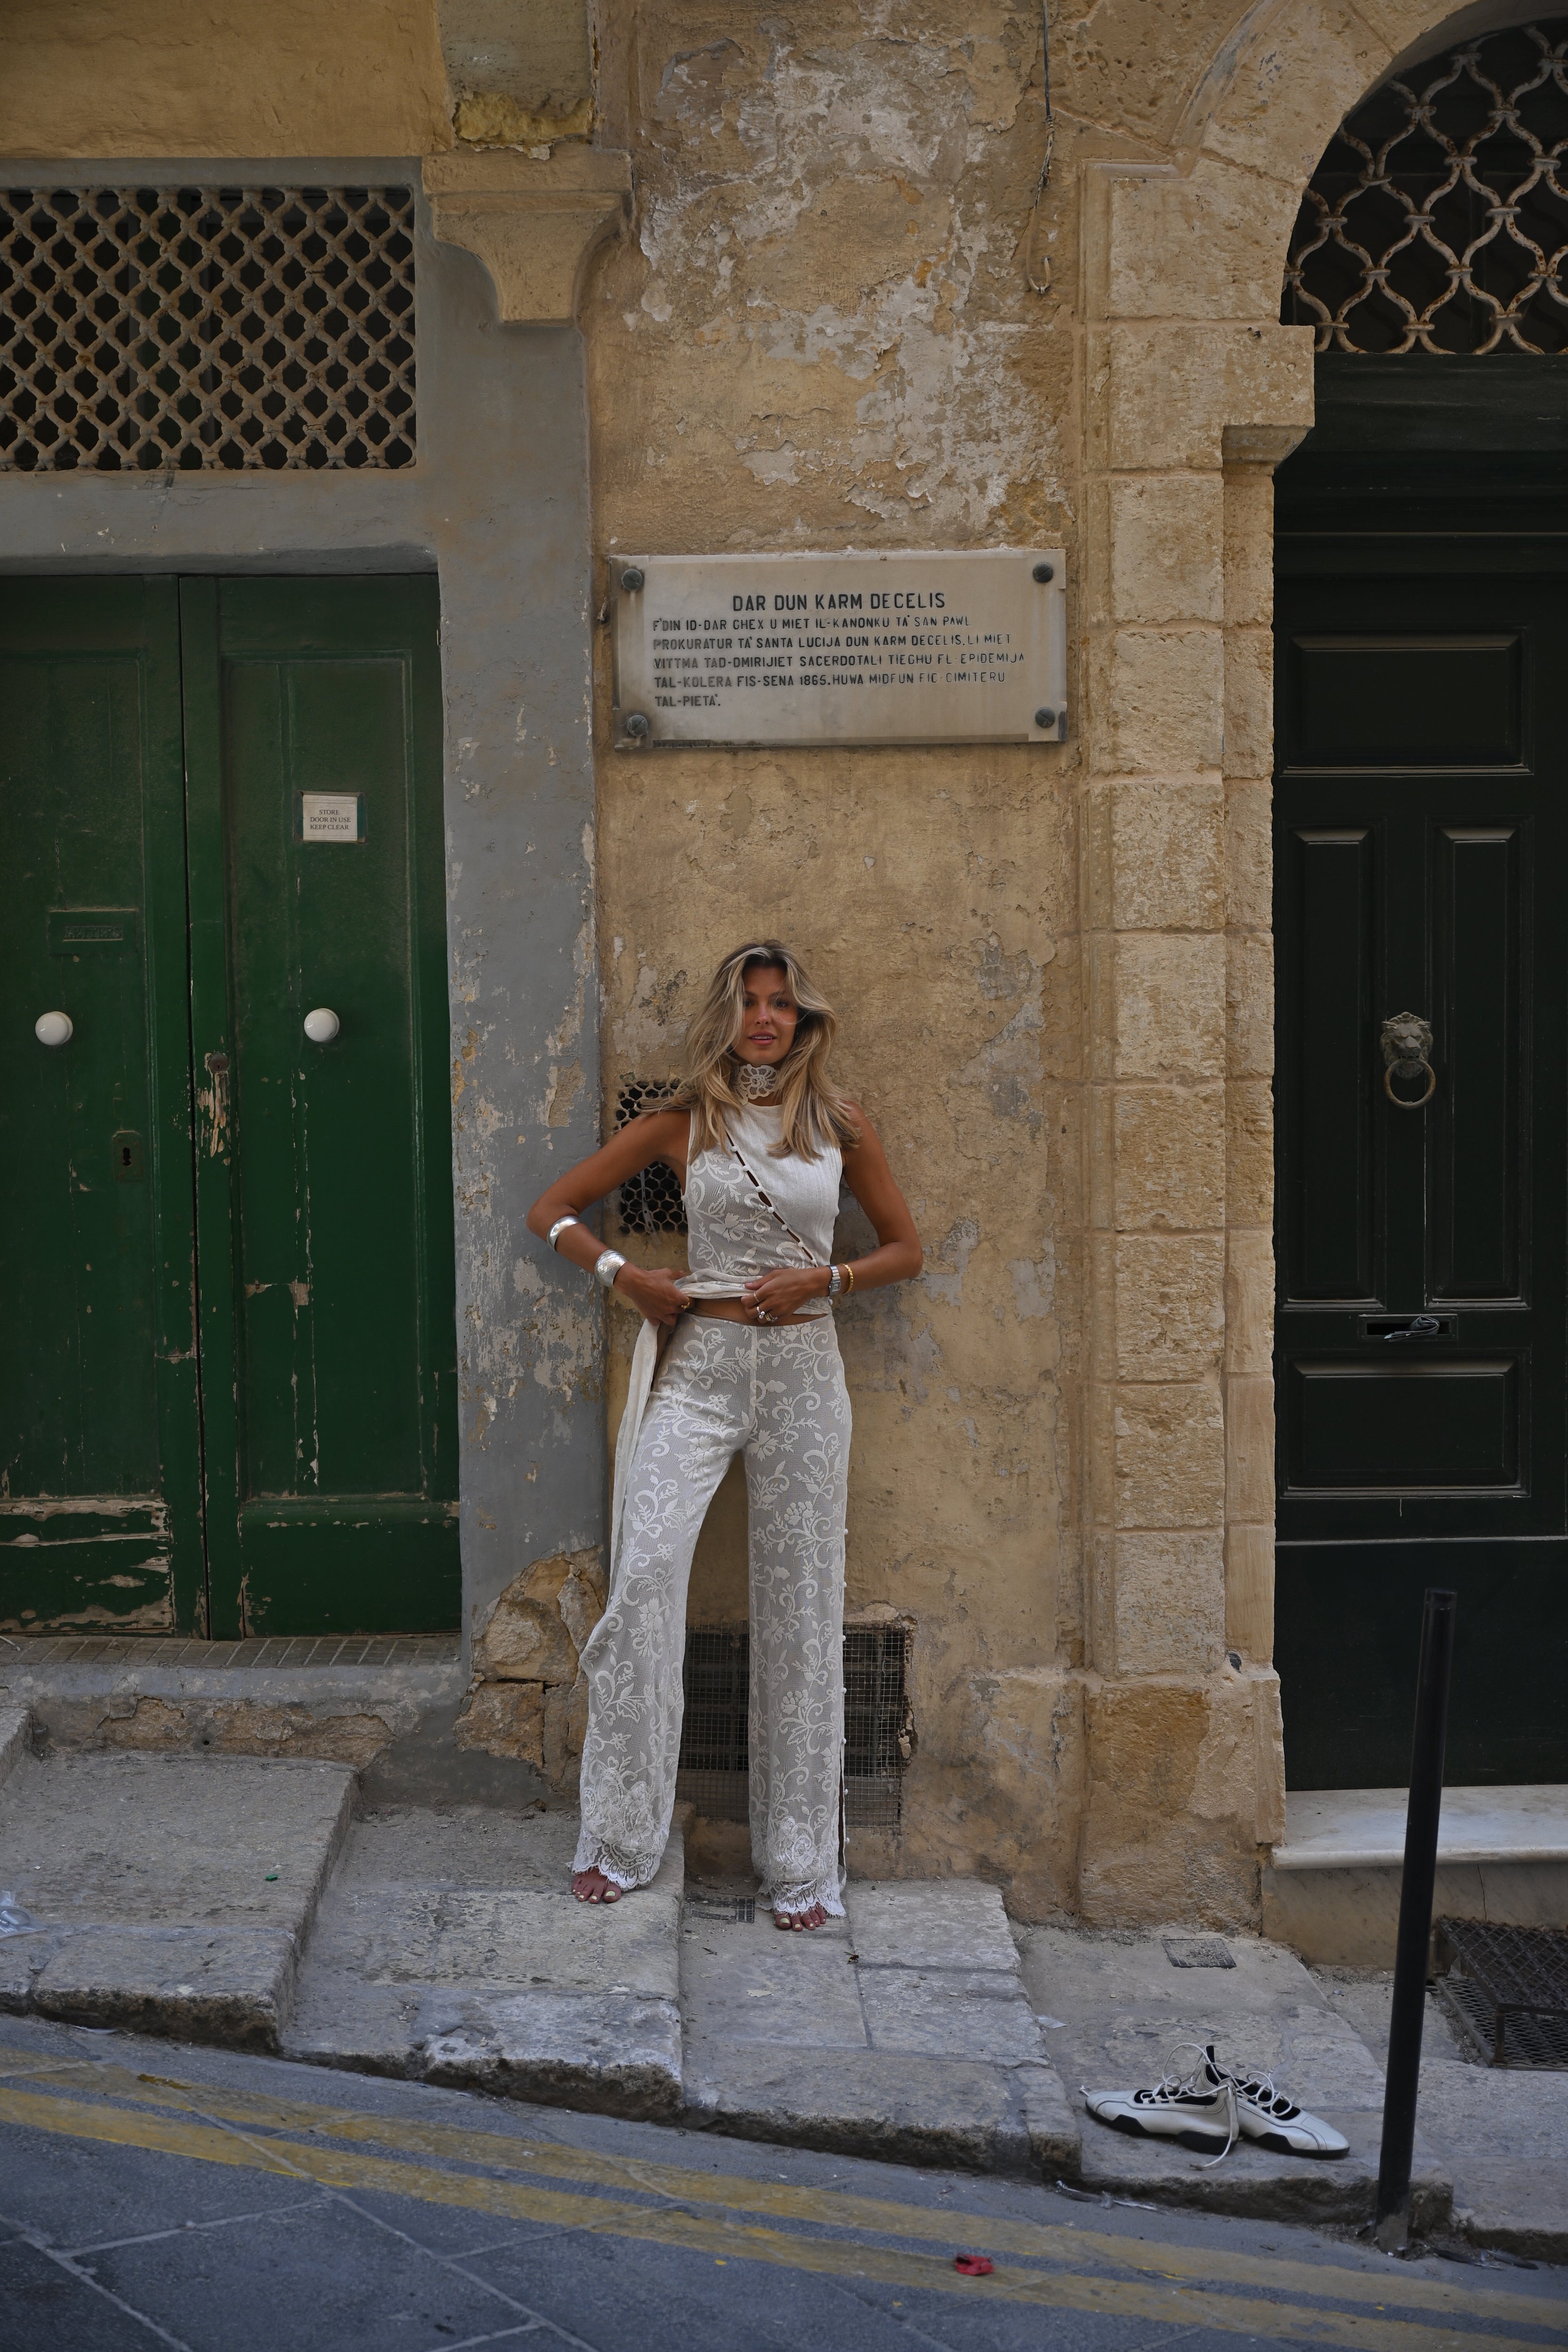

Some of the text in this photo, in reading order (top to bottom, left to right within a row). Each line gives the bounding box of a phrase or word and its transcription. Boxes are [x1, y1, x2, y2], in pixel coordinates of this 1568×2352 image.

[733, 593, 945, 611] DAR DUN KARM DECELIS
[686, 620, 726, 630] ID-DAR
[733, 619, 763, 630] GHEX
[771, 619, 776, 629] U
[783, 619, 809, 628] MIET
[816, 618, 890, 628] IL-KANONKU
[915, 617, 937, 627] SAN
[943, 616, 971, 626] PAWL
[653, 638, 732, 650] PROKURATUR
[756, 637, 793, 648] SANTA
[799, 637, 840, 648] LUCIJA
[846, 636, 868, 646] DUN
[875, 636, 906, 646] KARM
[985, 634, 1011, 644] MIET
[654, 658, 698, 668] VITTMA
[704, 656, 792, 668] TAD-DMIRIJIET
[889, 654, 931, 665] TIEGHU
[655, 676, 732, 688] TAL-KOLERA
[738, 675, 793, 686] FIS-SENA
[869, 674, 913, 684] MIDFUN
